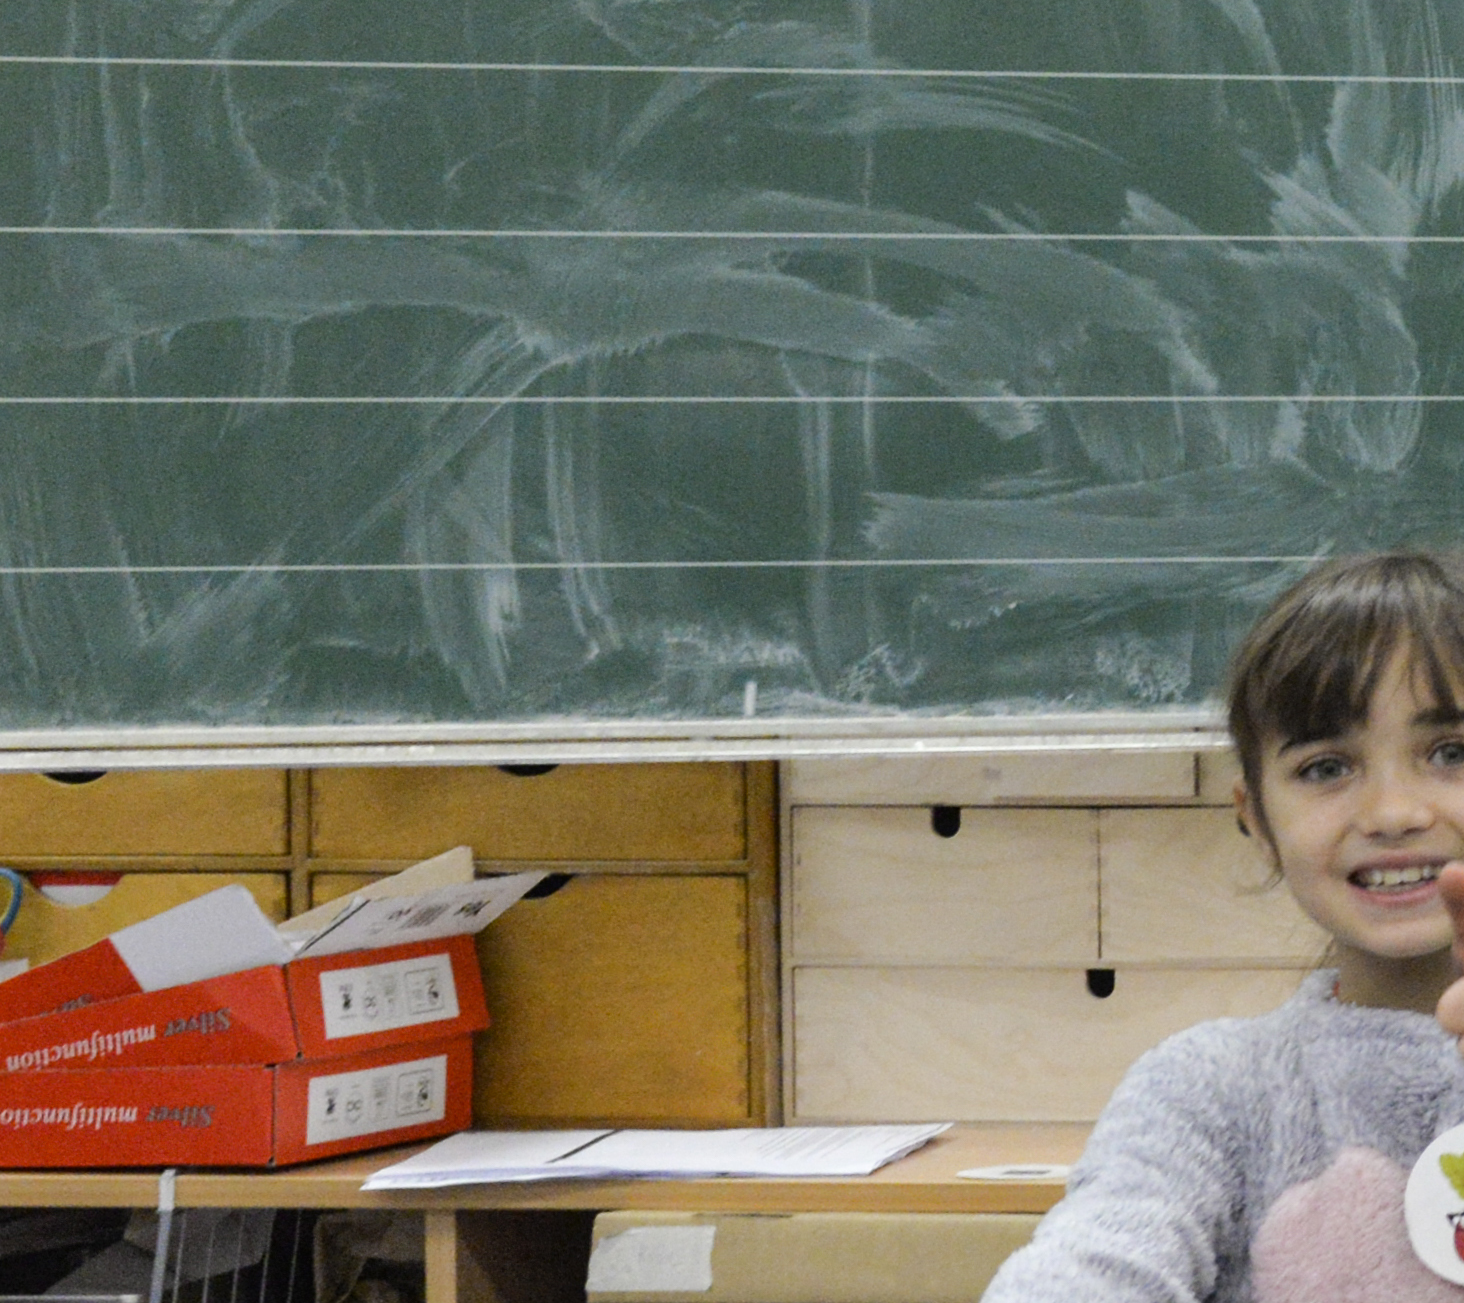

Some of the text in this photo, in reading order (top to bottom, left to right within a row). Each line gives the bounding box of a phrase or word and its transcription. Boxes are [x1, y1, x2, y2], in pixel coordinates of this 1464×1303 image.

[6, 1007, 231, 1072] Silver multifunction
[0, 1102, 216, 1130] Silver multifunctio
